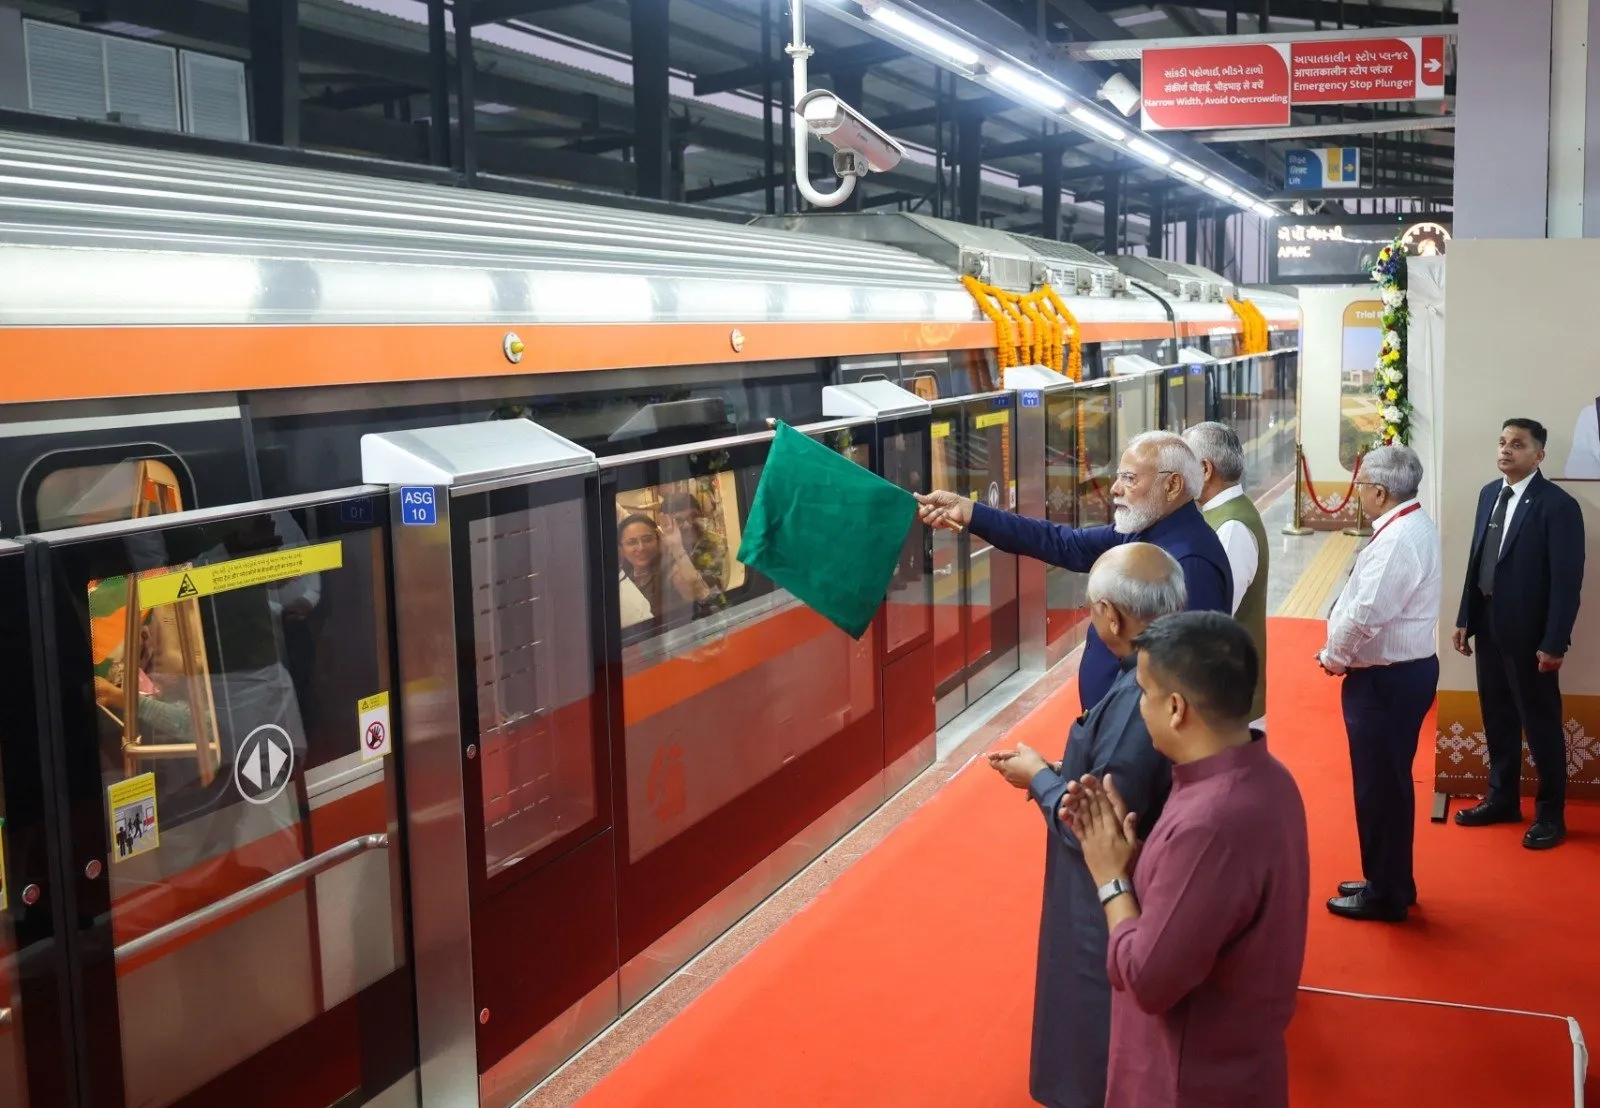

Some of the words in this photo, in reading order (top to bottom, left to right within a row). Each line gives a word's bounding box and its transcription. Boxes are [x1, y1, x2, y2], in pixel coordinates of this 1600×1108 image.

[1294, 51, 1351, 64] આપાતકાલીન
[1355, 50, 1376, 62] સ્ટોપ
[1294, 66, 1347, 77] आपातकालीन
[1349, 64, 1368, 75] स्टोप
[1243, 80, 1250, 90] से
[1293, 82, 1348, 92] Emergency
[1350, 80, 1372, 90] Stop
[1375, 78, 1413, 90] Plunger
[1144, 98, 1174, 107] Narrow
[1176, 96, 1204, 106] Width,
[1204, 95, 1228, 104] Avoid
[1230, 94, 1288, 104] Overcrowding
[1278, 246, 1310, 258] APMC
[404, 492, 432, 504] ASG
[412, 508, 426, 520] 10
